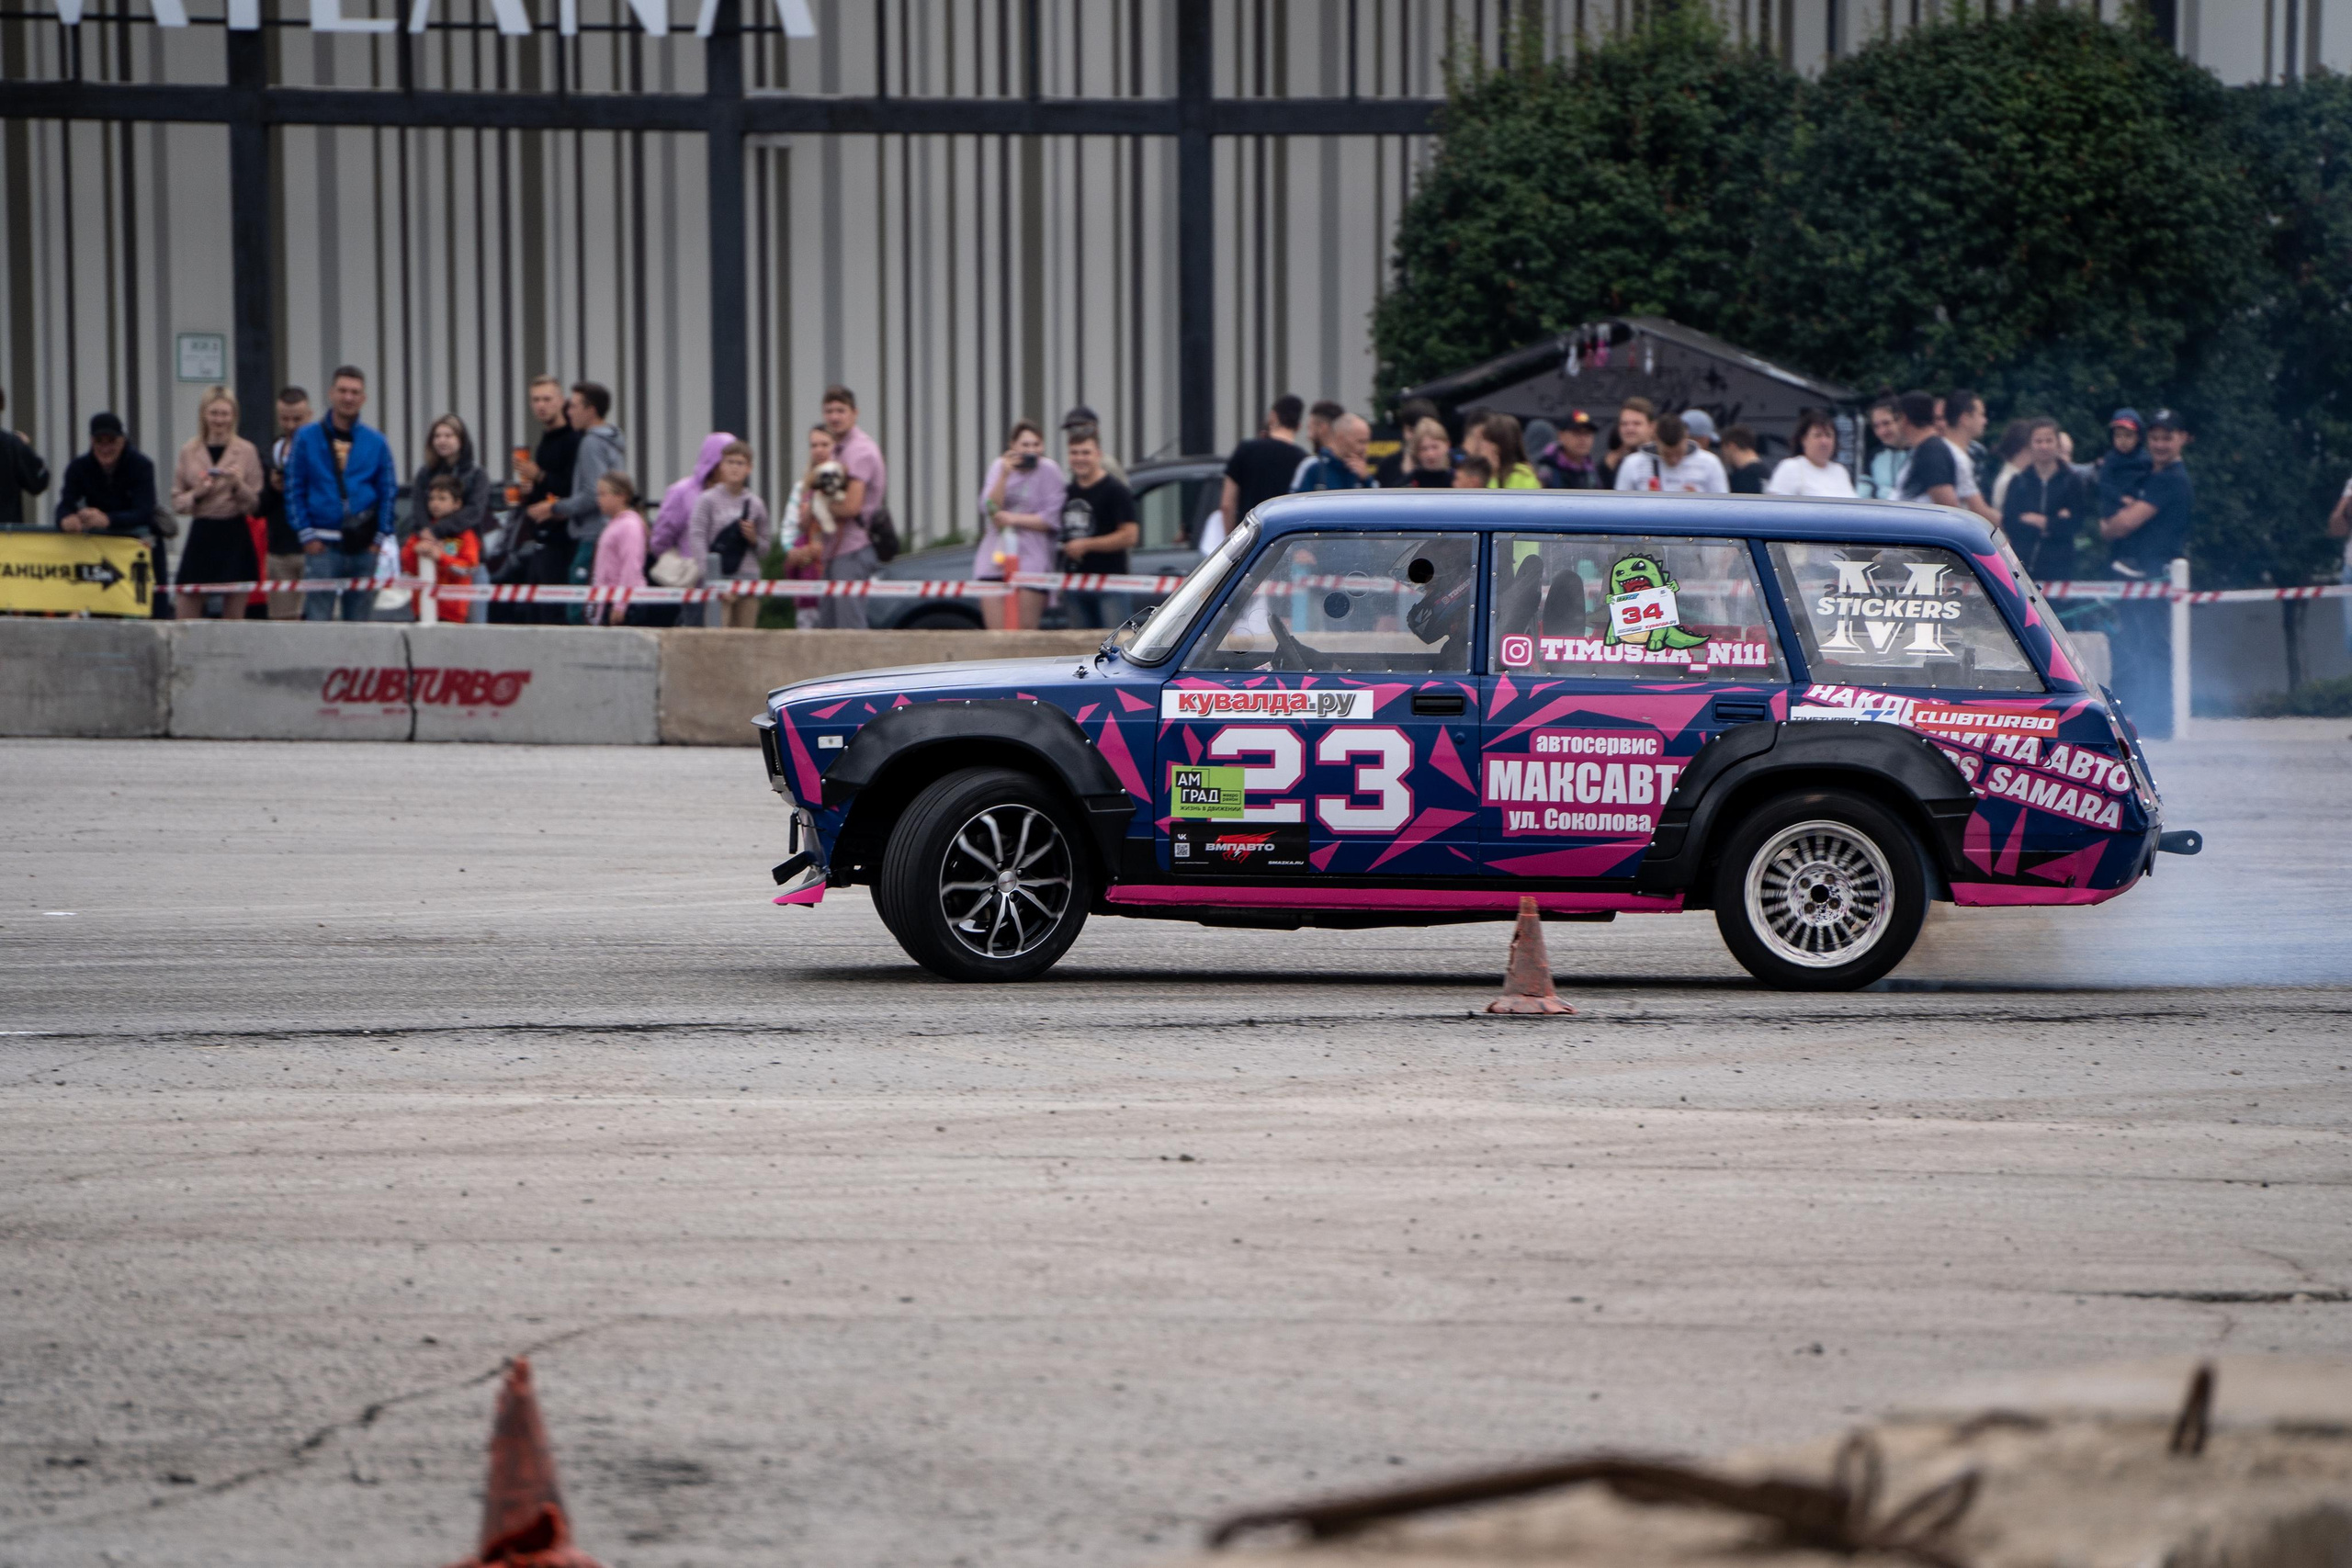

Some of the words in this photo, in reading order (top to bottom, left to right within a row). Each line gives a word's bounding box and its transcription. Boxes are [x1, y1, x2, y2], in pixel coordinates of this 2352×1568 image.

[0, 562, 71, 581] АНЦИЯ
[1622, 603, 1664, 625] 34
[1816, 597, 1962, 620] STICKERS
[322, 667, 532, 707] CLUBTURBO
[1178, 692, 1357, 717] кувалда.ру
[1916, 710, 2057, 730] CLUBTURBO
[1536, 735, 1657, 756] автосервис
[1991, 733, 2041, 765] НА
[2042, 746, 2132, 792] АВТО
[1177, 773, 1201, 786] АМ
[1208, 726, 1414, 834] 23
[1488, 760, 1687, 805] МАКСАВТ
[1182, 789, 1219, 803] ГРАД
[1509, 810, 1539, 830] ул.
[1205, 843, 1275, 852] ВМПАВТО
